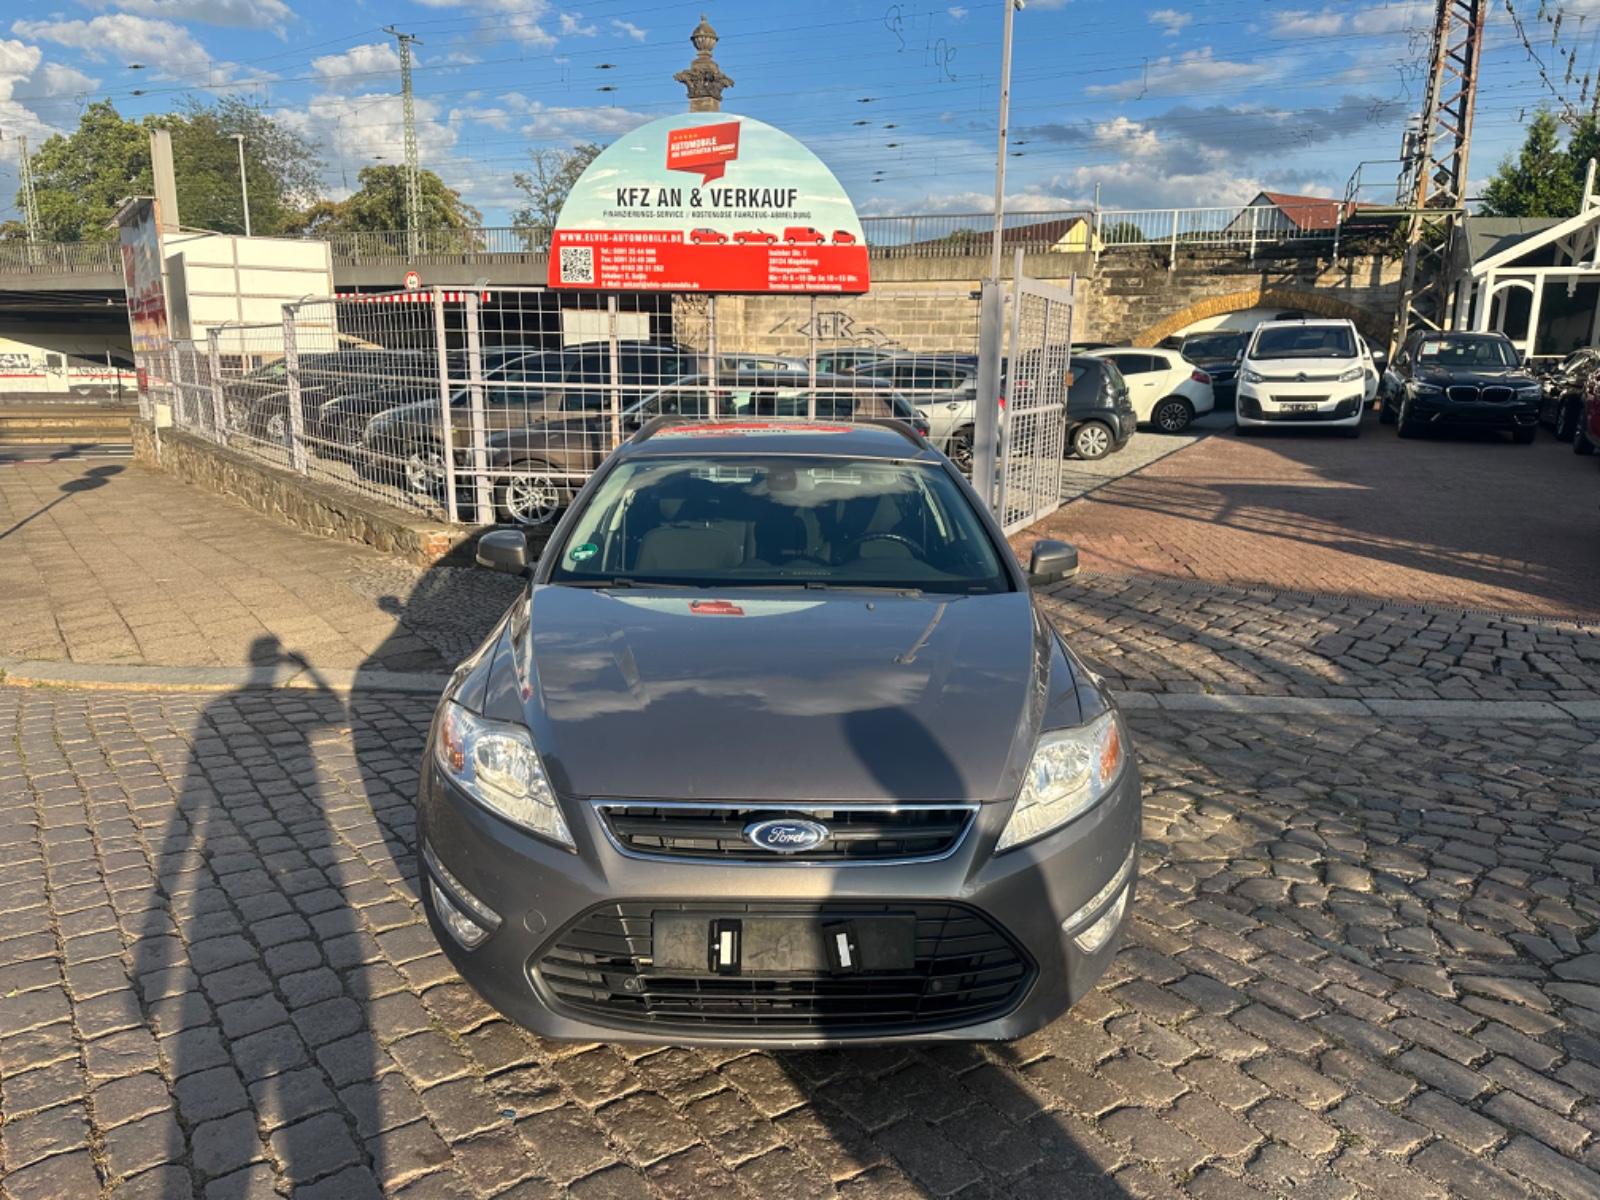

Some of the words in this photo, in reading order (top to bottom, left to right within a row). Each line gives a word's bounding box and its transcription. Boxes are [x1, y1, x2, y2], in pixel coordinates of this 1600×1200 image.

[671, 136, 717, 151] AUTOMOBILE
[617, 188, 650, 207] KFZ
[657, 188, 681, 207] AN
[690, 188, 702, 207] &
[710, 188, 798, 208] VERKAUF
[603, 210, 684, 218] FINANZIERUNGS-SERVICE
[692, 210, 732, 218] KOSTENLOSE
[560, 233, 682, 243] WWW.ELVIS-AUTOMOBILE.DE
[767, 826, 806, 843] Ford
